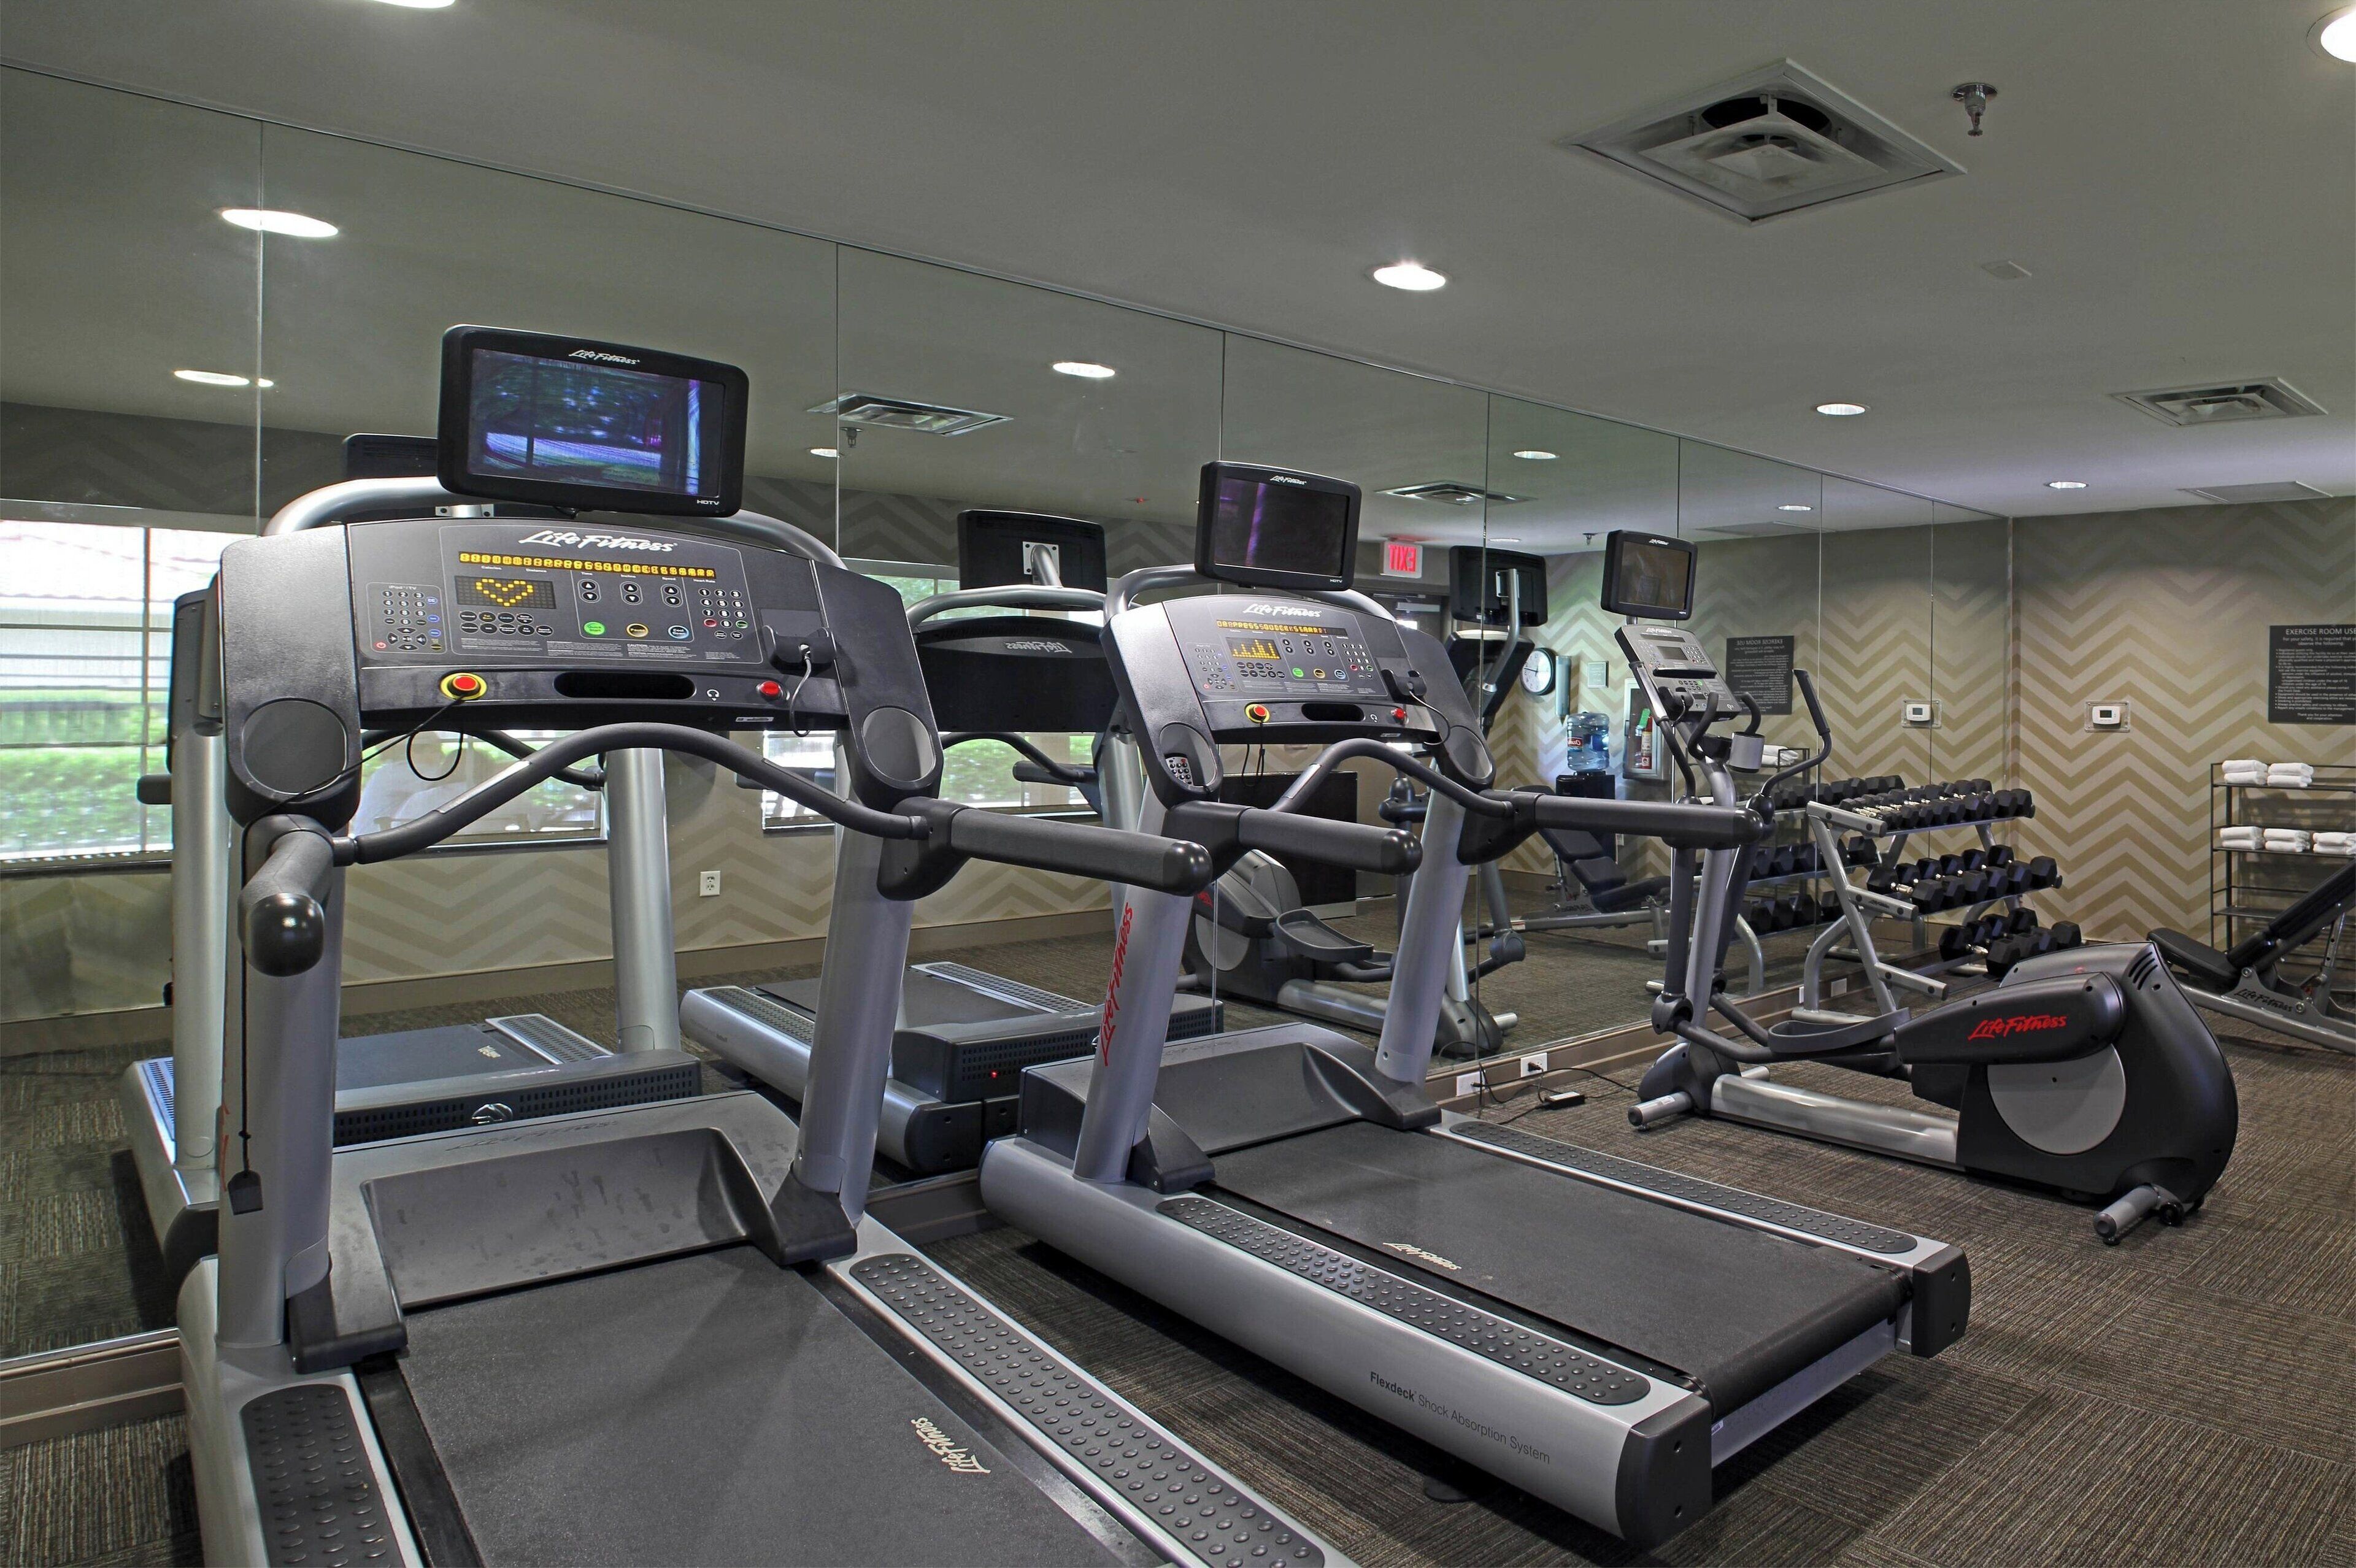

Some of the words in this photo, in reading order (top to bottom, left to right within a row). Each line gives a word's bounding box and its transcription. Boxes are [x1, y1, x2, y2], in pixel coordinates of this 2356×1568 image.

[1418, 1394, 1449, 1418] Shock
[1451, 1410, 1506, 1444] Absorption
[1510, 1436, 1550, 1464] System
